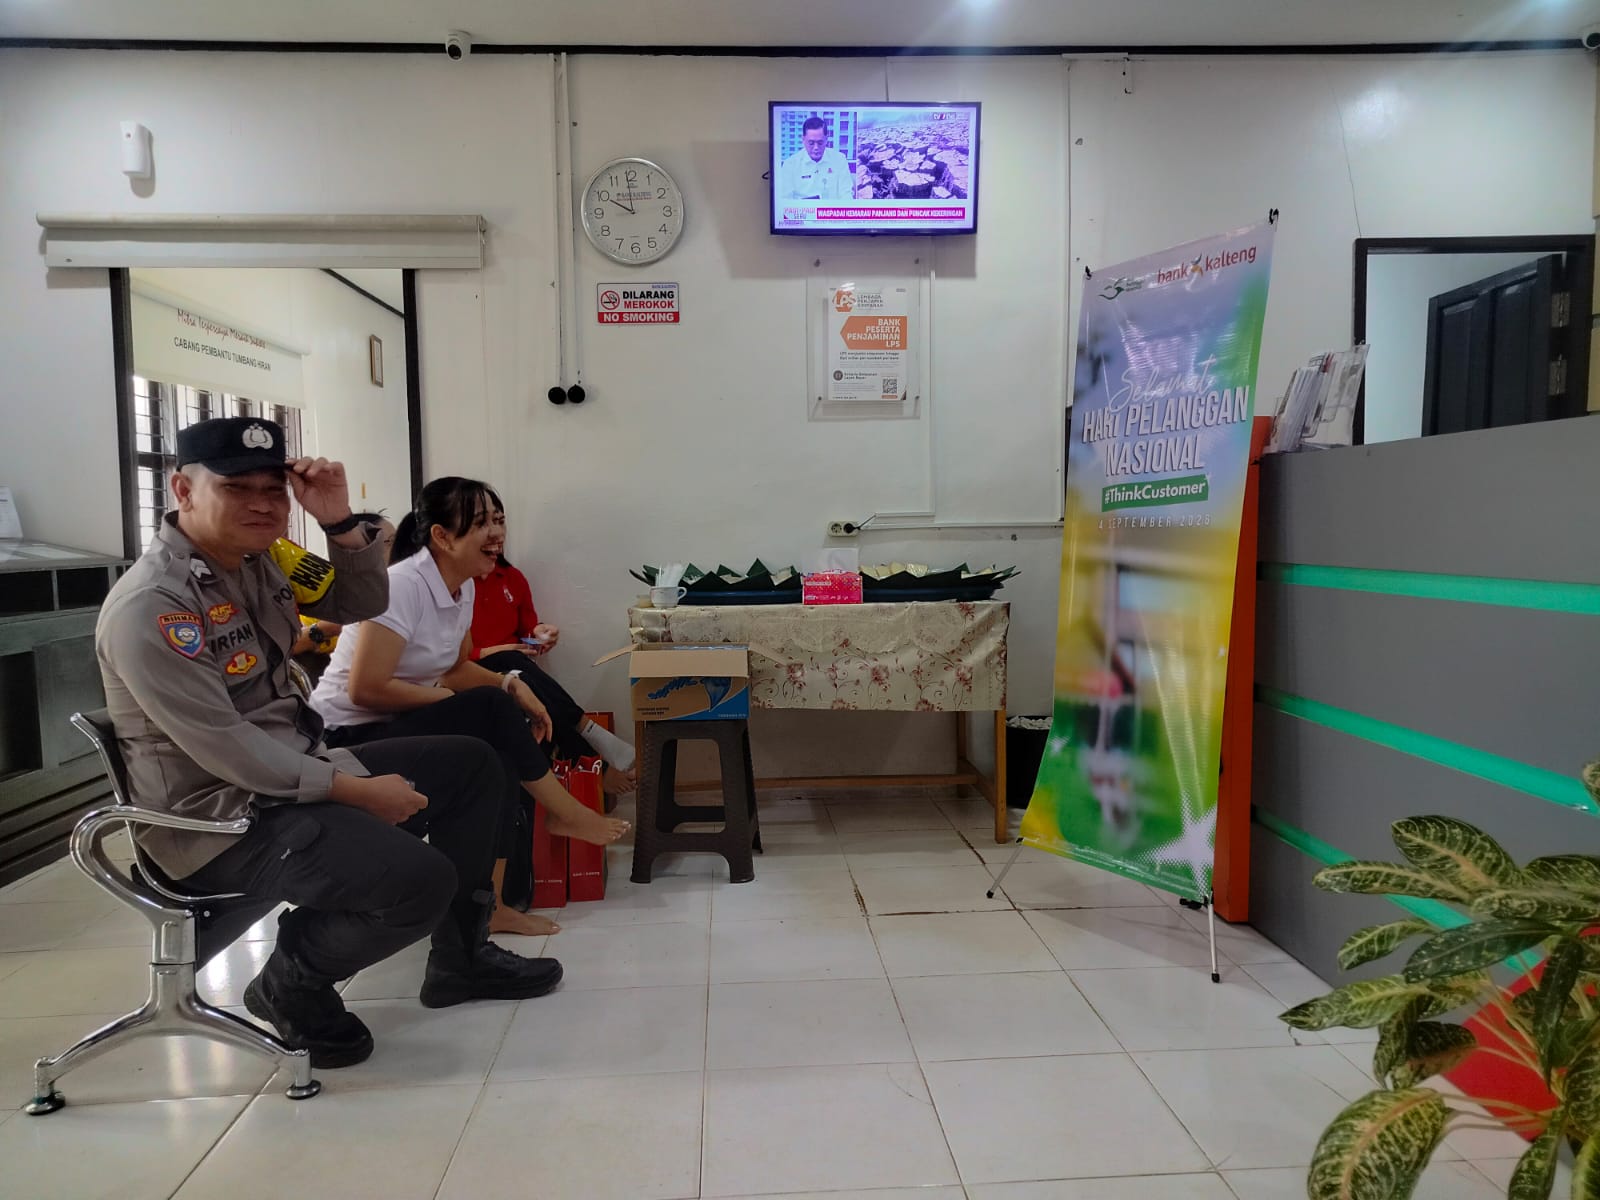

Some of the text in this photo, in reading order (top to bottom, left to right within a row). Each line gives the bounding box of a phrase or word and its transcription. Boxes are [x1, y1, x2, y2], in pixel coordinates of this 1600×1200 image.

[656, 188, 667, 199] 2
[594, 208, 604, 219] 9
[663, 206, 673, 217] 3
[601, 225, 611, 236] 8
[658, 224, 668, 235] 4
[615, 238, 625, 250] 7
[648, 237, 657, 248] 5
[631, 243, 641, 254] 6
[1157, 246, 1257, 284] bank kalteng
[623, 290, 674, 299] DILARANG
[623, 300, 674, 309] MEROKOK
[603, 312, 674, 322] NO SMOKING
[878, 318, 900, 326] BANK
[174, 336, 200, 353] CABANG
[201, 344, 232, 361] PEMBANTU
[885, 340, 900, 348] LPS
[1109, 354, 1217, 413] Selamat
[1082, 385, 1249, 443] HARI PELANGGAN
[1105, 434, 1204, 477] NASIONAL
[1104, 481, 1206, 504] #ThinkCustomer
[1108, 515, 1172, 529] SEPTEMBER
[211, 623, 254, 652] IRFAN
